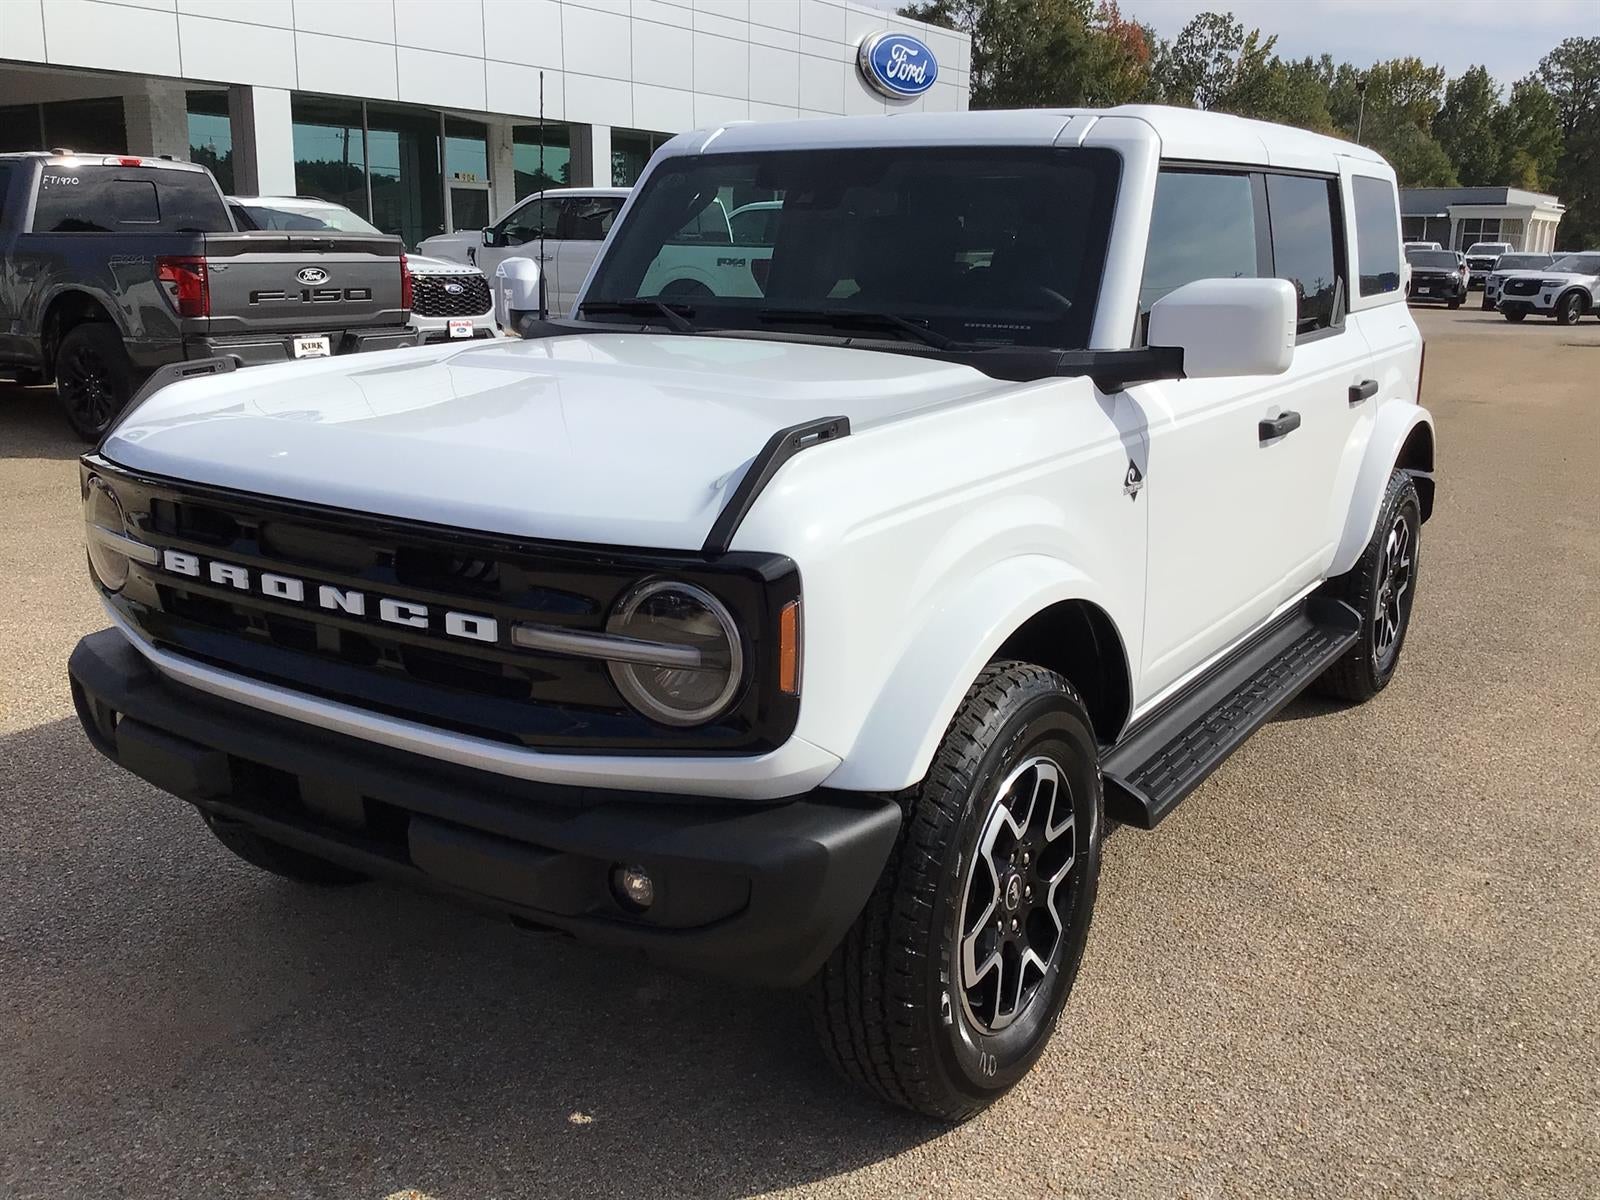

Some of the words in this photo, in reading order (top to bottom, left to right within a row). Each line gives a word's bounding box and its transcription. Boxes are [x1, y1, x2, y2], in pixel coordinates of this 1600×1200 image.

[886, 44, 928, 84] Ford
[249, 288, 373, 305] F-150
[301, 341, 324, 351] KIRK
[164, 549, 498, 643] BRONCO
